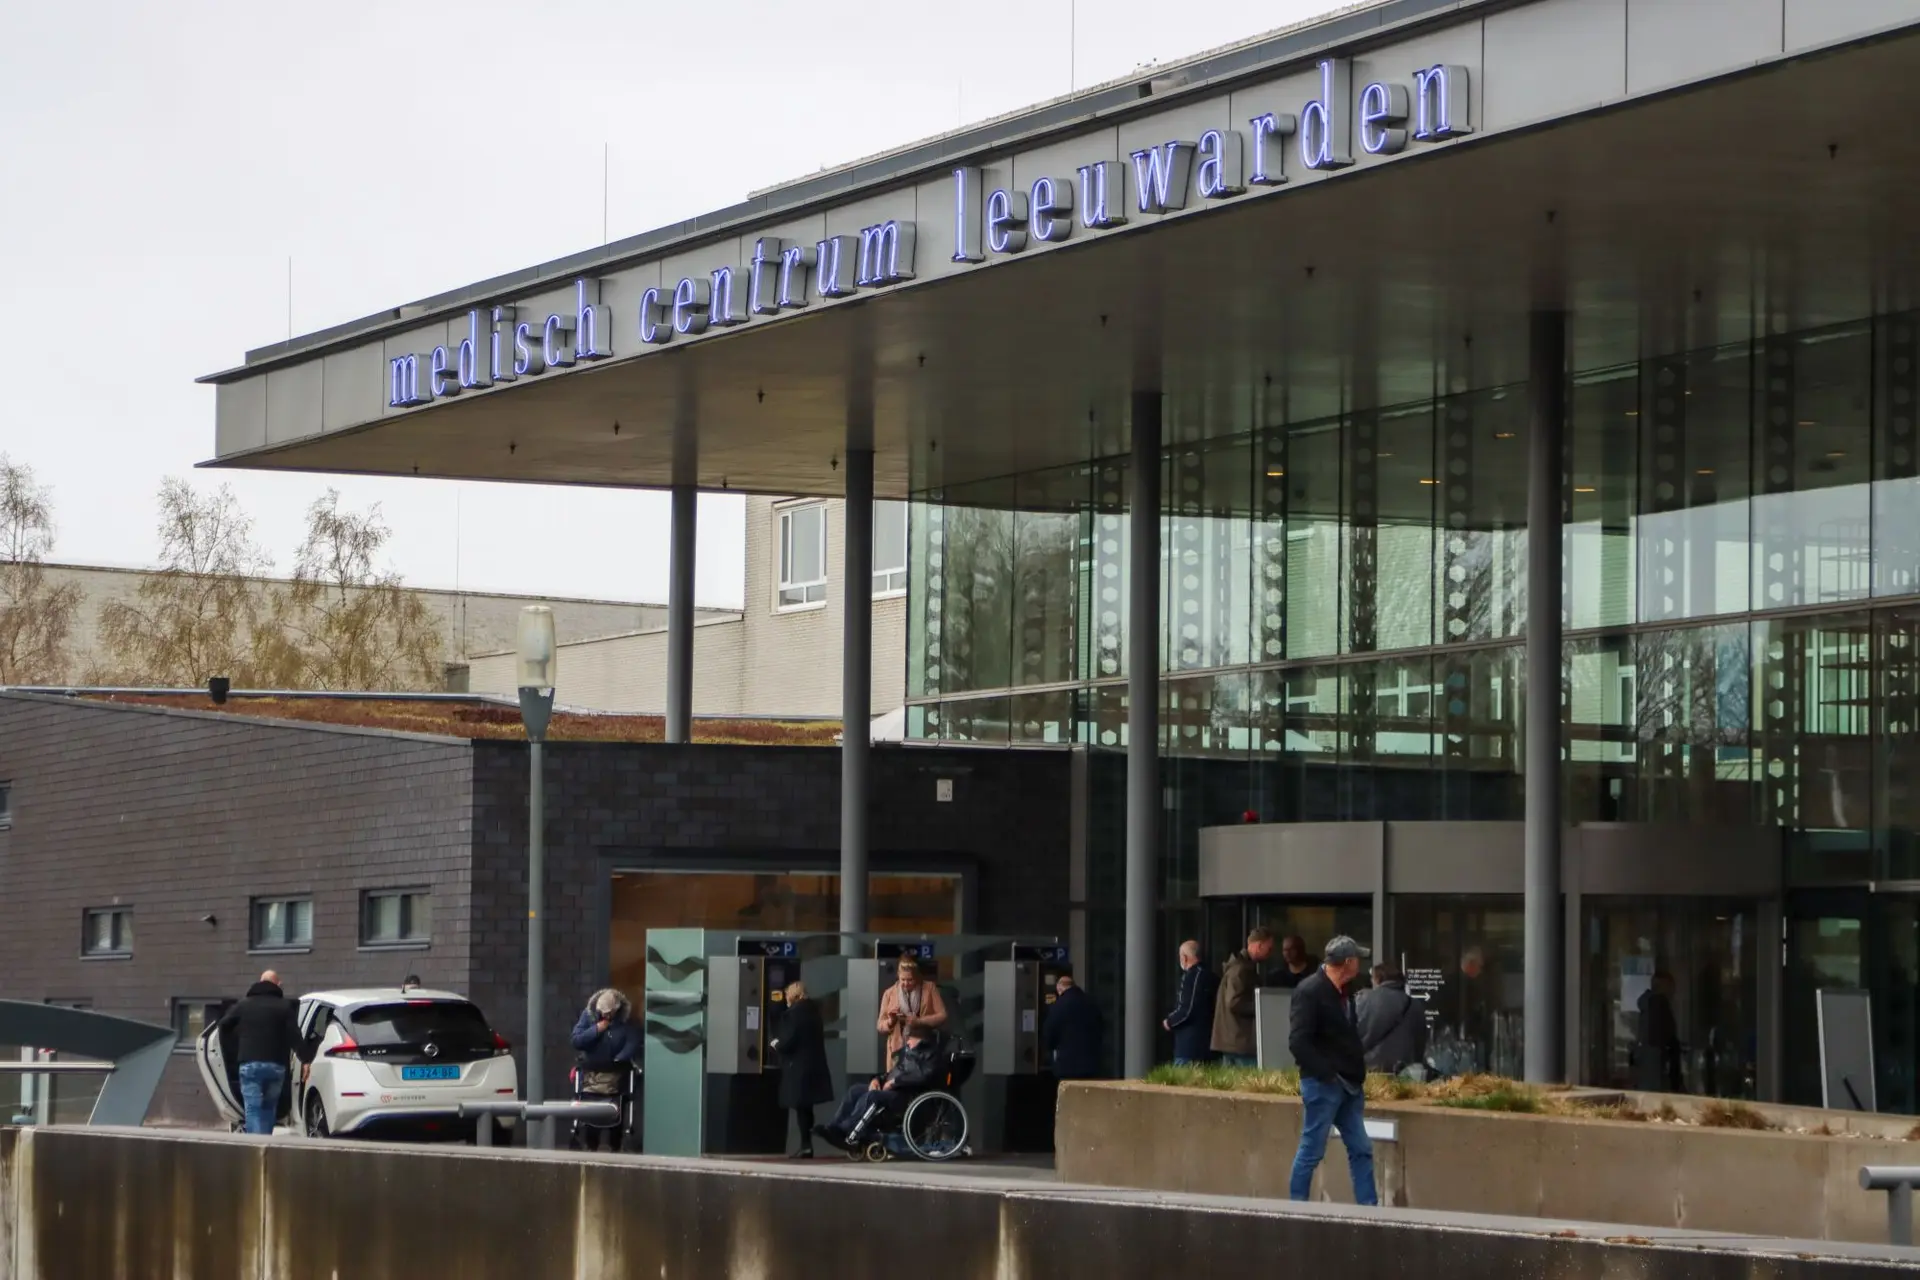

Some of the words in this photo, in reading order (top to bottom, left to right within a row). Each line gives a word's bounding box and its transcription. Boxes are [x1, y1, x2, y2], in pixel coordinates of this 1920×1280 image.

[390, 277, 608, 407] medisch
[639, 219, 912, 345] centrum
[951, 58, 1470, 265] leeuwarden
[784, 942, 793, 957] P
[921, 946, 930, 958] P
[1056, 948, 1066, 961] P
